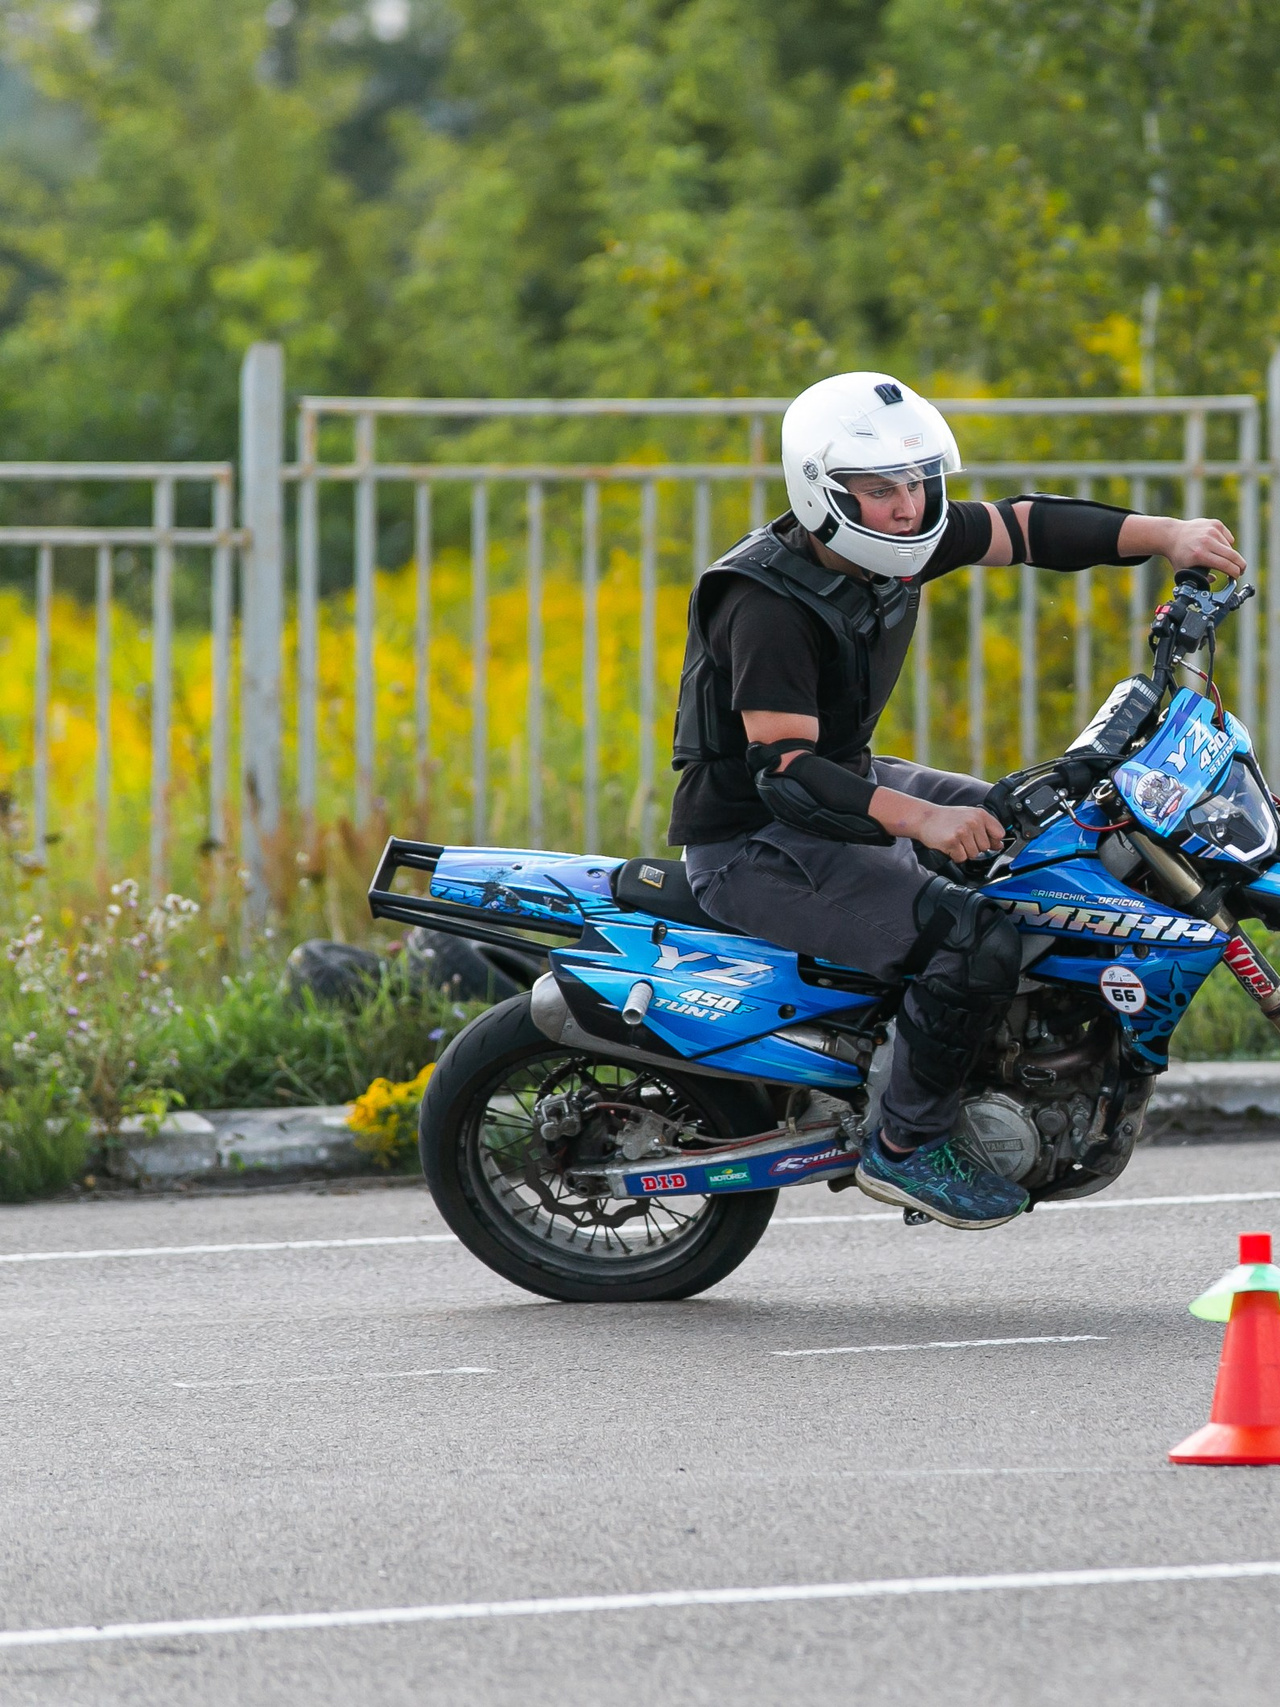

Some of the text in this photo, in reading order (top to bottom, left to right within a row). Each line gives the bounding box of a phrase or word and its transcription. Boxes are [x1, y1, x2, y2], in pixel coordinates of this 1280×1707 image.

[1165, 717, 1209, 772] YZ
[1200, 730, 1230, 770] 450
[1208, 736, 1237, 777] STUNT
[990, 898, 1217, 943] MAHA
[651, 943, 775, 988] YZ
[653, 996, 727, 1022] TUNT
[1111, 989, 1137, 1002] 66
[709, 1171, 748, 1182] MOTOREX
[771, 1148, 848, 1173] Renth
